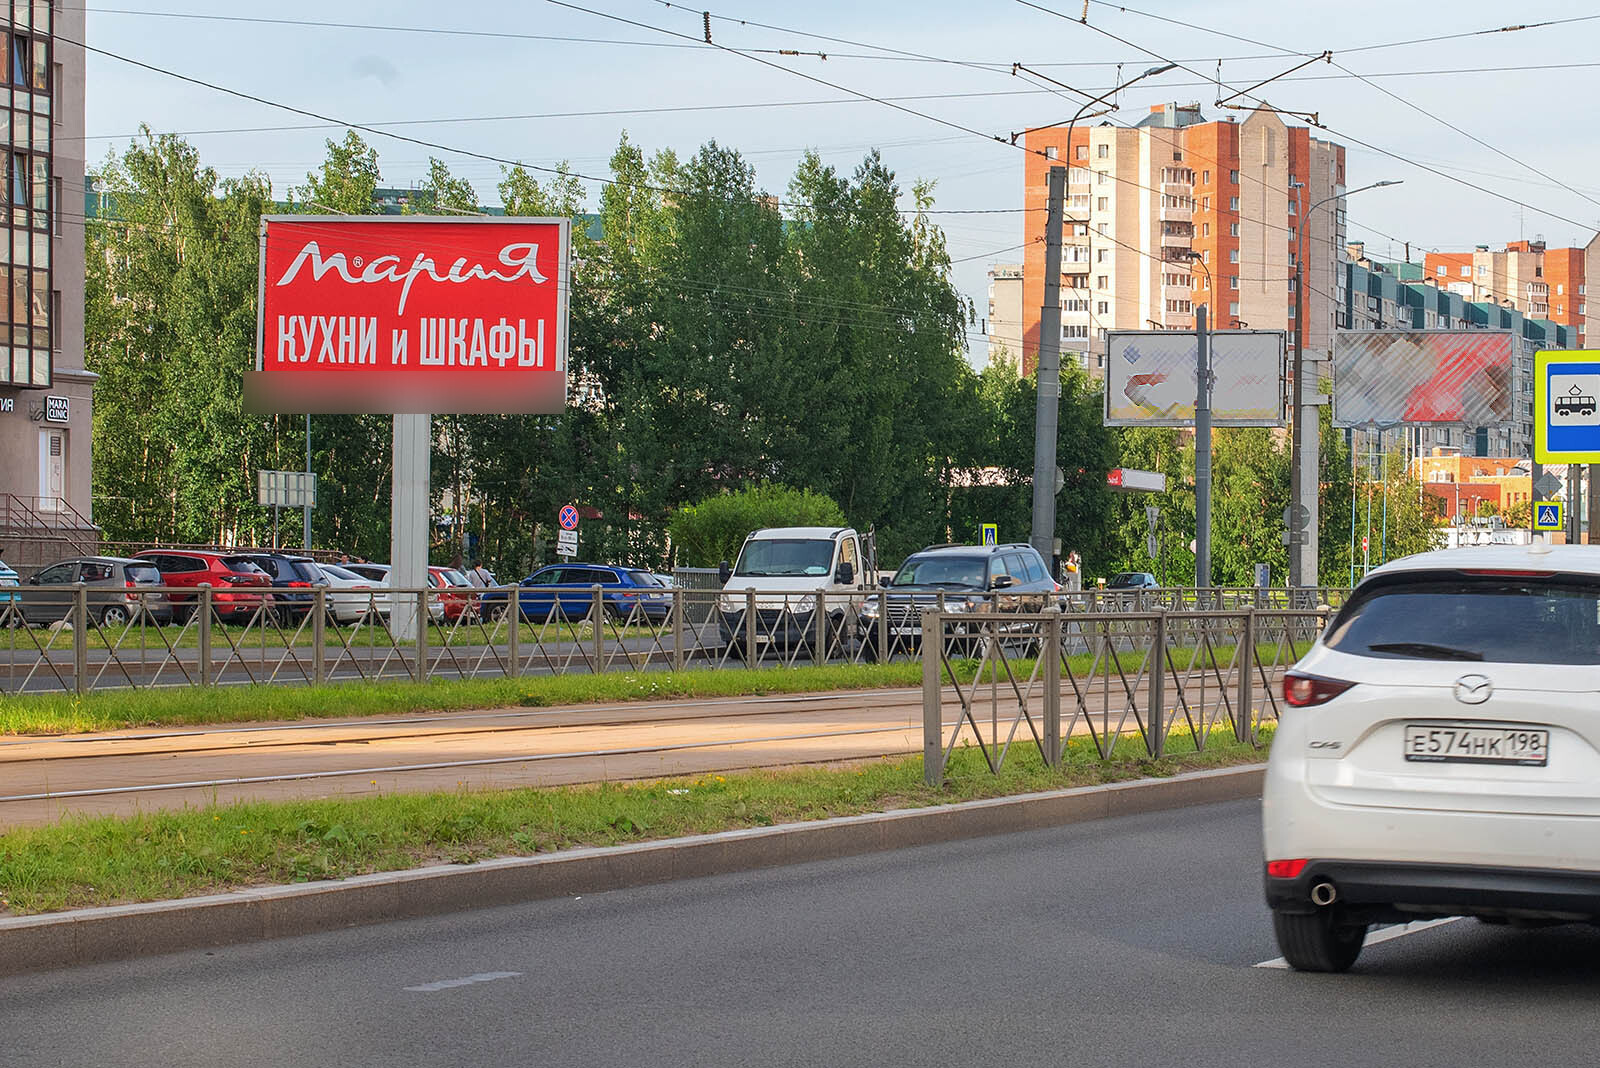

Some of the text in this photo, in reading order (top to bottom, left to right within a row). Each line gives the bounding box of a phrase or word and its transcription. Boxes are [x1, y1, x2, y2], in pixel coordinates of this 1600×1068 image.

[277, 315, 545, 367] КУХНИ и ШКАФЫ
[0, 398, 14, 411] ИЯ
[49, 399, 67, 409] MARA
[49, 409, 67, 419] CLINIC
[1505, 733, 1541, 751] 198
